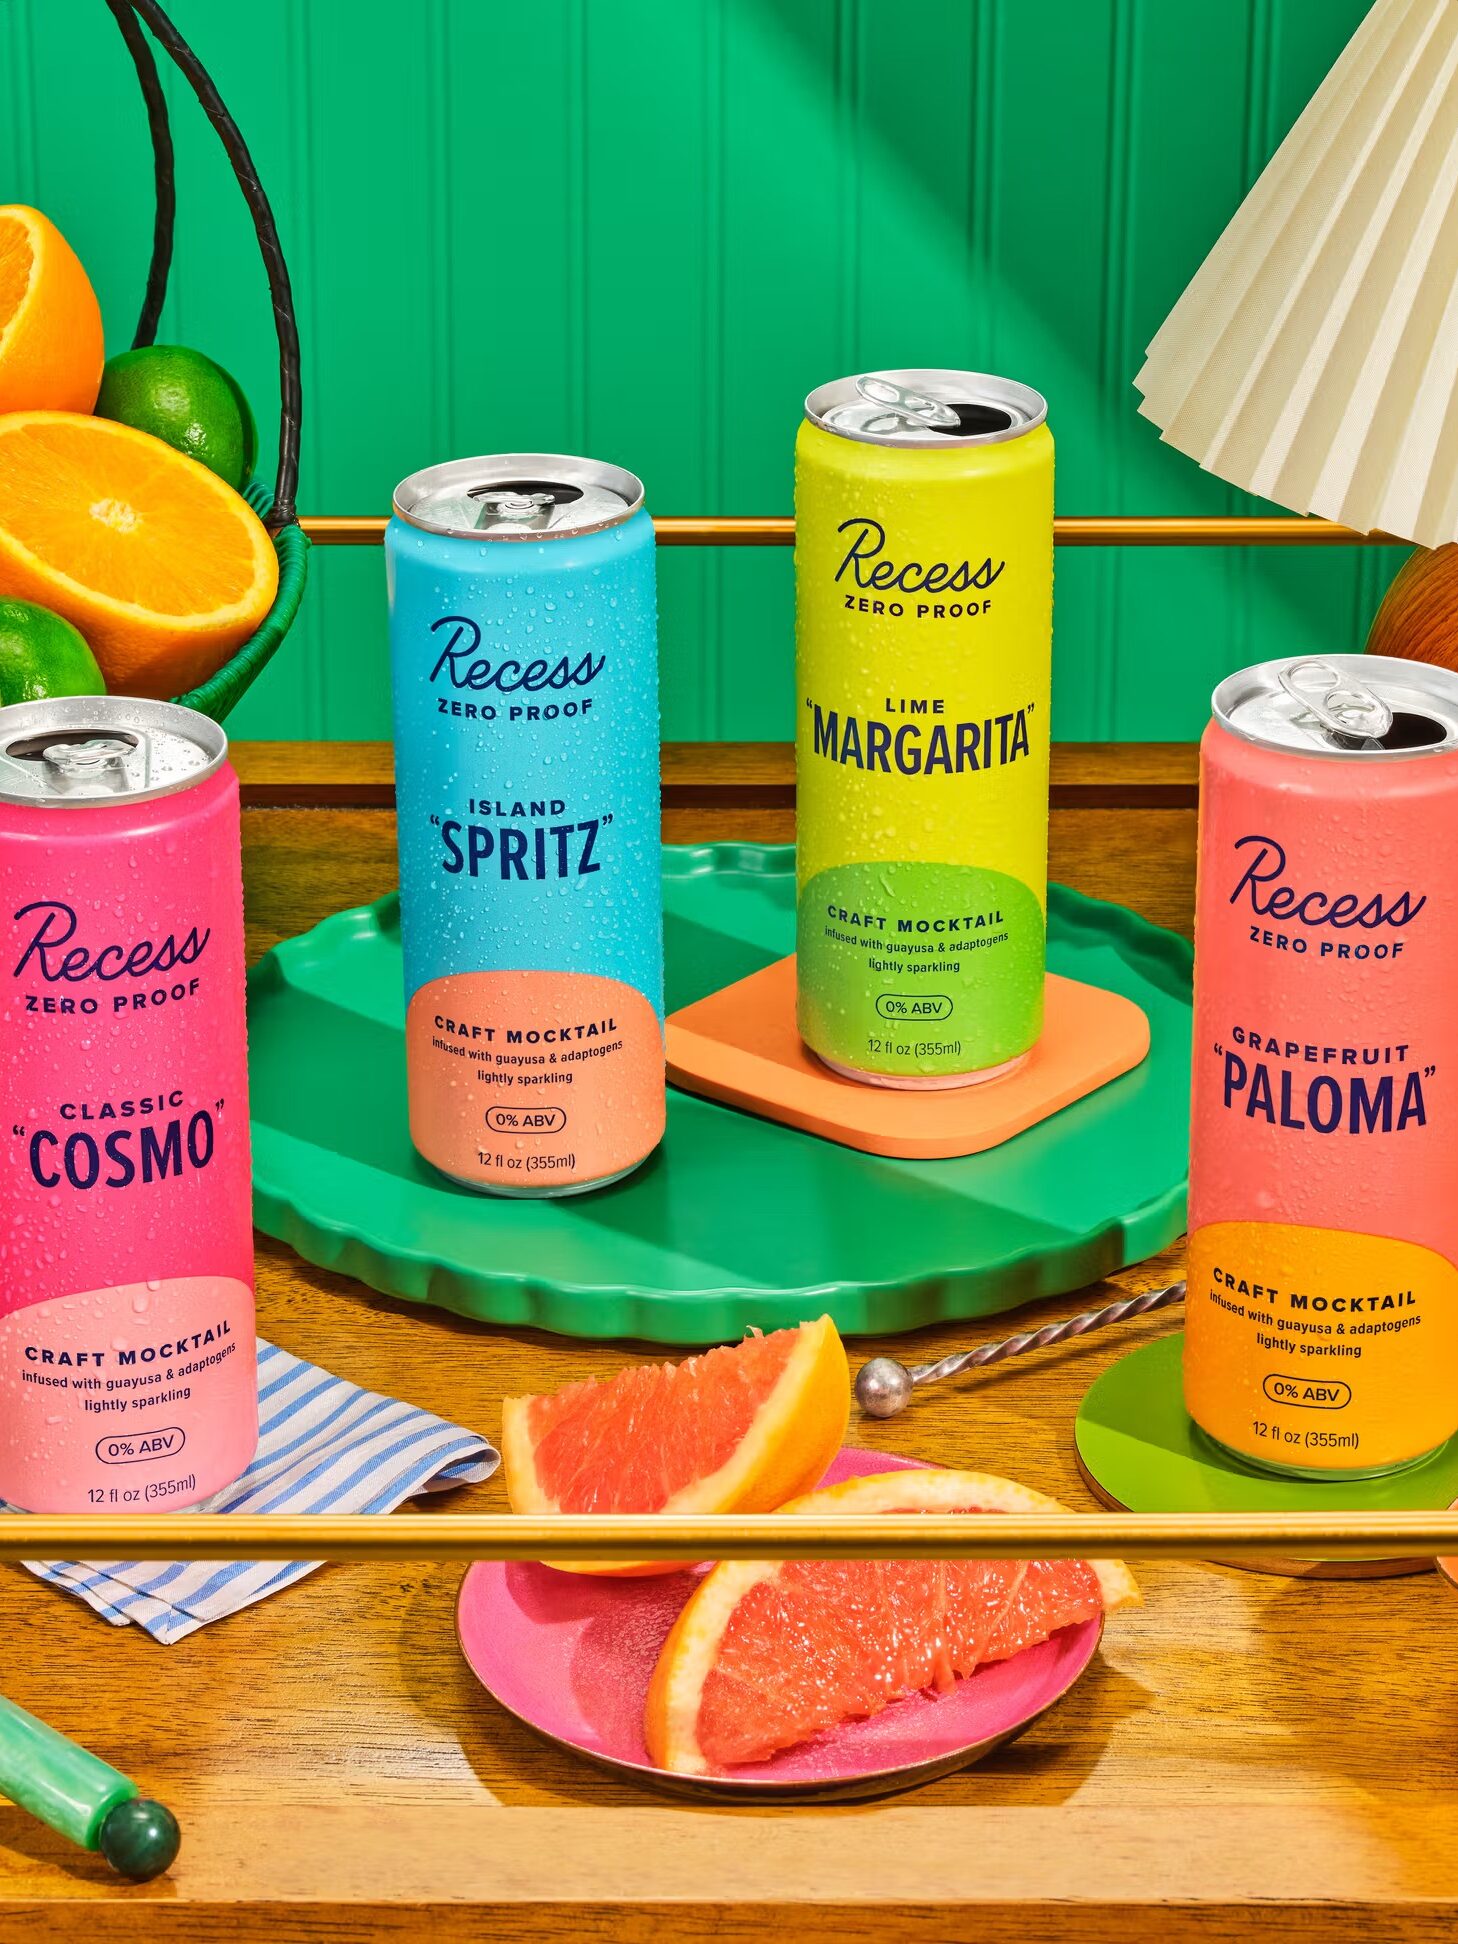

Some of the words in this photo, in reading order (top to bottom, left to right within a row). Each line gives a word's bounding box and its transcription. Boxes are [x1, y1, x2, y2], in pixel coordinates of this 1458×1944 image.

[835, 518, 1005, 593] Recess
[844, 595, 904, 617] ZERO
[917, 600, 992, 619] PROOF
[429, 616, 606, 692] Recess
[437, 697, 497, 720] ZERO
[509, 699, 593, 721] PROOF
[886, 698, 945, 714] LIME
[469, 798, 565, 817] ISLAND
[1230, 835, 1427, 929] Recess
[827, 905, 886, 929] CRAFT
[898, 911, 1004, 933] MOCKTAIL
[14, 901, 211, 983] Recess
[825, 925, 857, 945] infused
[860, 938, 883, 949] with
[887, 942, 934, 955] guayusa
[938, 943, 945, 952] &
[949, 932, 1008, 952] adaptogens
[1249, 926, 1308, 953] ZERO
[1321, 942, 1405, 959] PROOF
[869, 958, 903, 973] lightly
[907, 962, 960, 974] sparkling
[25, 995, 98, 1014] ZERO
[114, 978, 200, 1013] PROOF
[886, 1001, 907, 1013] 0%
[911, 1002, 943, 1013] ABV
[434, 1015, 495, 1041] CRAFT
[506, 1018, 617, 1043] MOCKTAIL
[432, 1036, 465, 1056] infused
[468, 1050, 491, 1062] with
[496, 1053, 545, 1066] guayusa
[549, 1053, 557, 1063] &
[561, 1040, 623, 1062] adaptogens
[868, 1039, 880, 1052] 12
[885, 1042, 892, 1053] fl
[896, 1045, 910, 1055] oz
[914, 1041, 961, 1057] (355ml)
[1232, 1026, 1409, 1064] GRAPEFRUIT
[477, 1070, 513, 1085] lightly
[518, 1073, 573, 1086] sparkling
[60, 1090, 184, 1121] CLASSIC
[496, 1113, 518, 1126] 0%
[523, 1114, 556, 1126] ABV
[478, 1152, 491, 1165] 12
[496, 1155, 503, 1167] fl
[507, 1158, 522, 1168] oz
[526, 1154, 576, 1171] (355ml)
[1213, 1267, 1278, 1303] CRAFT
[1290, 1291, 1416, 1312] MOCKTAIL
[1210, 1289, 1244, 1316] infused
[1248, 1311, 1273, 1325] with
[1277, 1319, 1332, 1334] guayusa
[1336, 1324, 1345, 1334] &
[1350, 1315, 1421, 1335] adaptogens
[25, 1346, 105, 1367] CRAFT
[119, 1320, 231, 1365] MOCKTAIL
[1257, 1333, 1296, 1353] lightly
[1300, 1344, 1362, 1358] sparkling
[22, 1370, 68, 1388] infused
[72, 1378, 101, 1389] with
[106, 1374, 161, 1391] guayusa
[166, 1369, 174, 1379] &
[178, 1342, 236, 1377] adaptogens
[85, 1400, 127, 1413] lightly
[132, 1388, 191, 1408] sparkling
[1274, 1382, 1298, 1398] 0%
[1303, 1389, 1339, 1401] ABV
[108, 1443, 134, 1456] 0%
[139, 1435, 174, 1454] ABV
[1253, 1421, 1267, 1437] 12
[1272, 1427, 1280, 1440] fl
[1285, 1432, 1300, 1444] oz
[1305, 1432, 1359, 1449] (355ml)
[88, 1489, 104, 1503] 12
[110, 1488, 118, 1502] fl
[123, 1491, 140, 1501] oz
[145, 1474, 196, 1502] (355ml)
